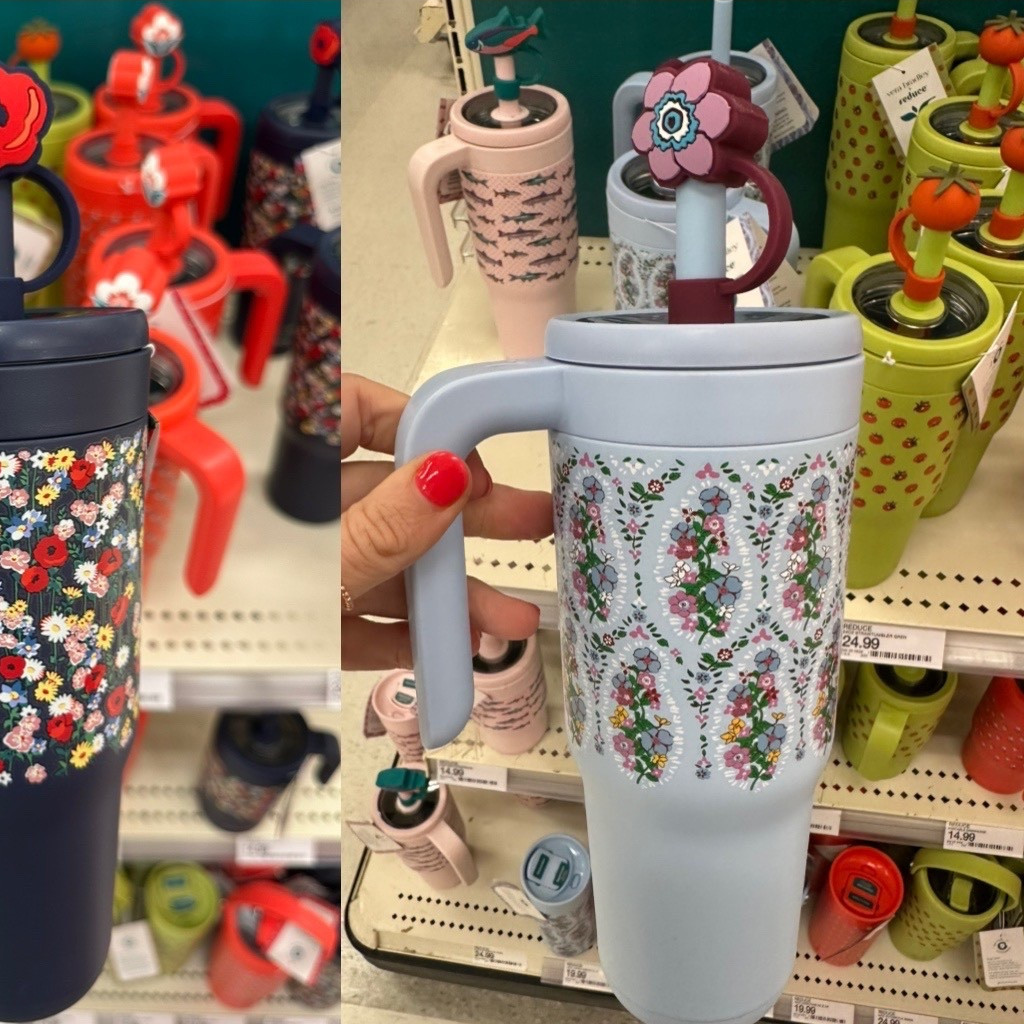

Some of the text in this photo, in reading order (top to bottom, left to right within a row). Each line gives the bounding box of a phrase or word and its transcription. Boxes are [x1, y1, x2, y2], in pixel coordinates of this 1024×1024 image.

[899, 85, 927, 105] reduce
[843, 624, 872, 632] REDUCE
[842, 634, 880, 650] 24.99
[948, 830, 976, 842] 14.99
[795, 1004, 816, 1015] 19.99
